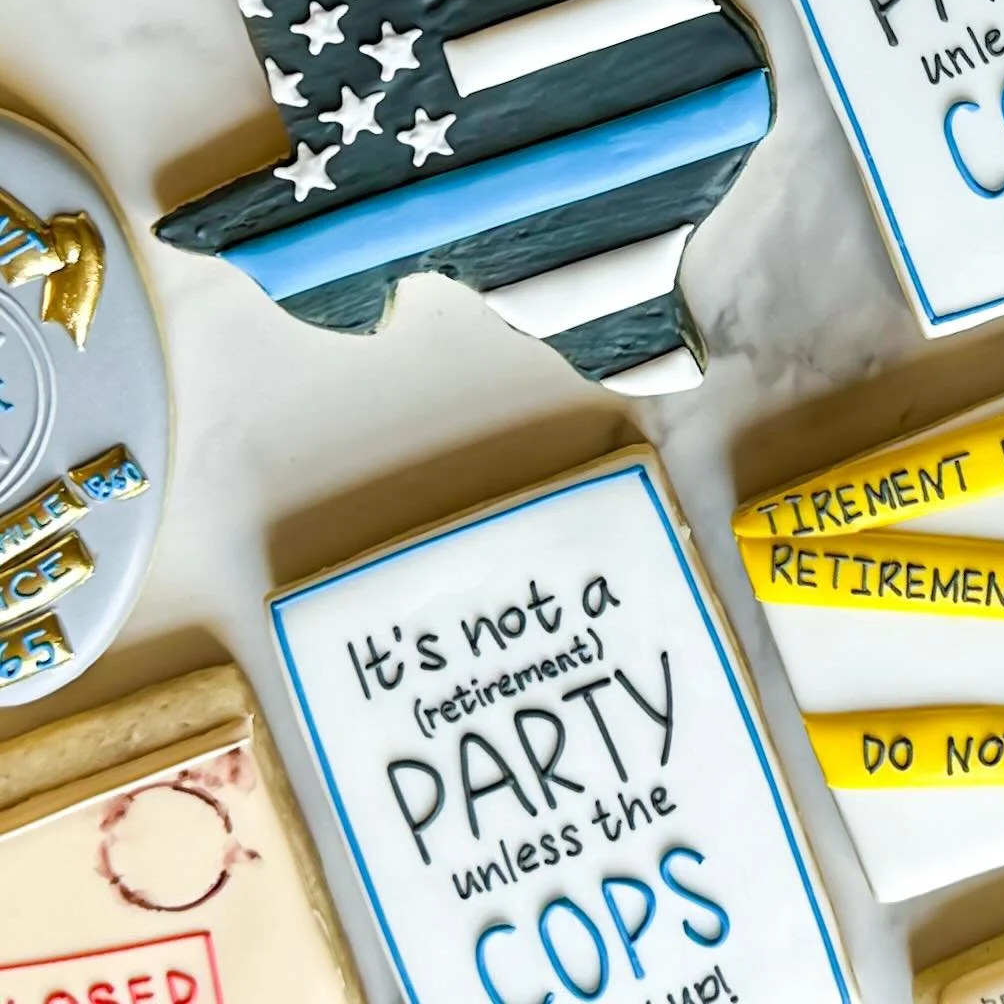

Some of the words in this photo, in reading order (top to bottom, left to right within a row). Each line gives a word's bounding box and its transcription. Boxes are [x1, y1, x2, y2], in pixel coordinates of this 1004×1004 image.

[757, 451, 970, 536] TIREMENT
[345, 623, 446, 698] It's
[461, 580, 563, 655] not
[581, 575, 621, 618] a
[412, 627, 605, 739] (retirement)
[386, 651, 675, 866] PARTY
[863, 732, 914, 775] DO
[452, 820, 583, 899] unless
[592, 783, 677, 843] the
[475, 847, 730, 1004] COPS
